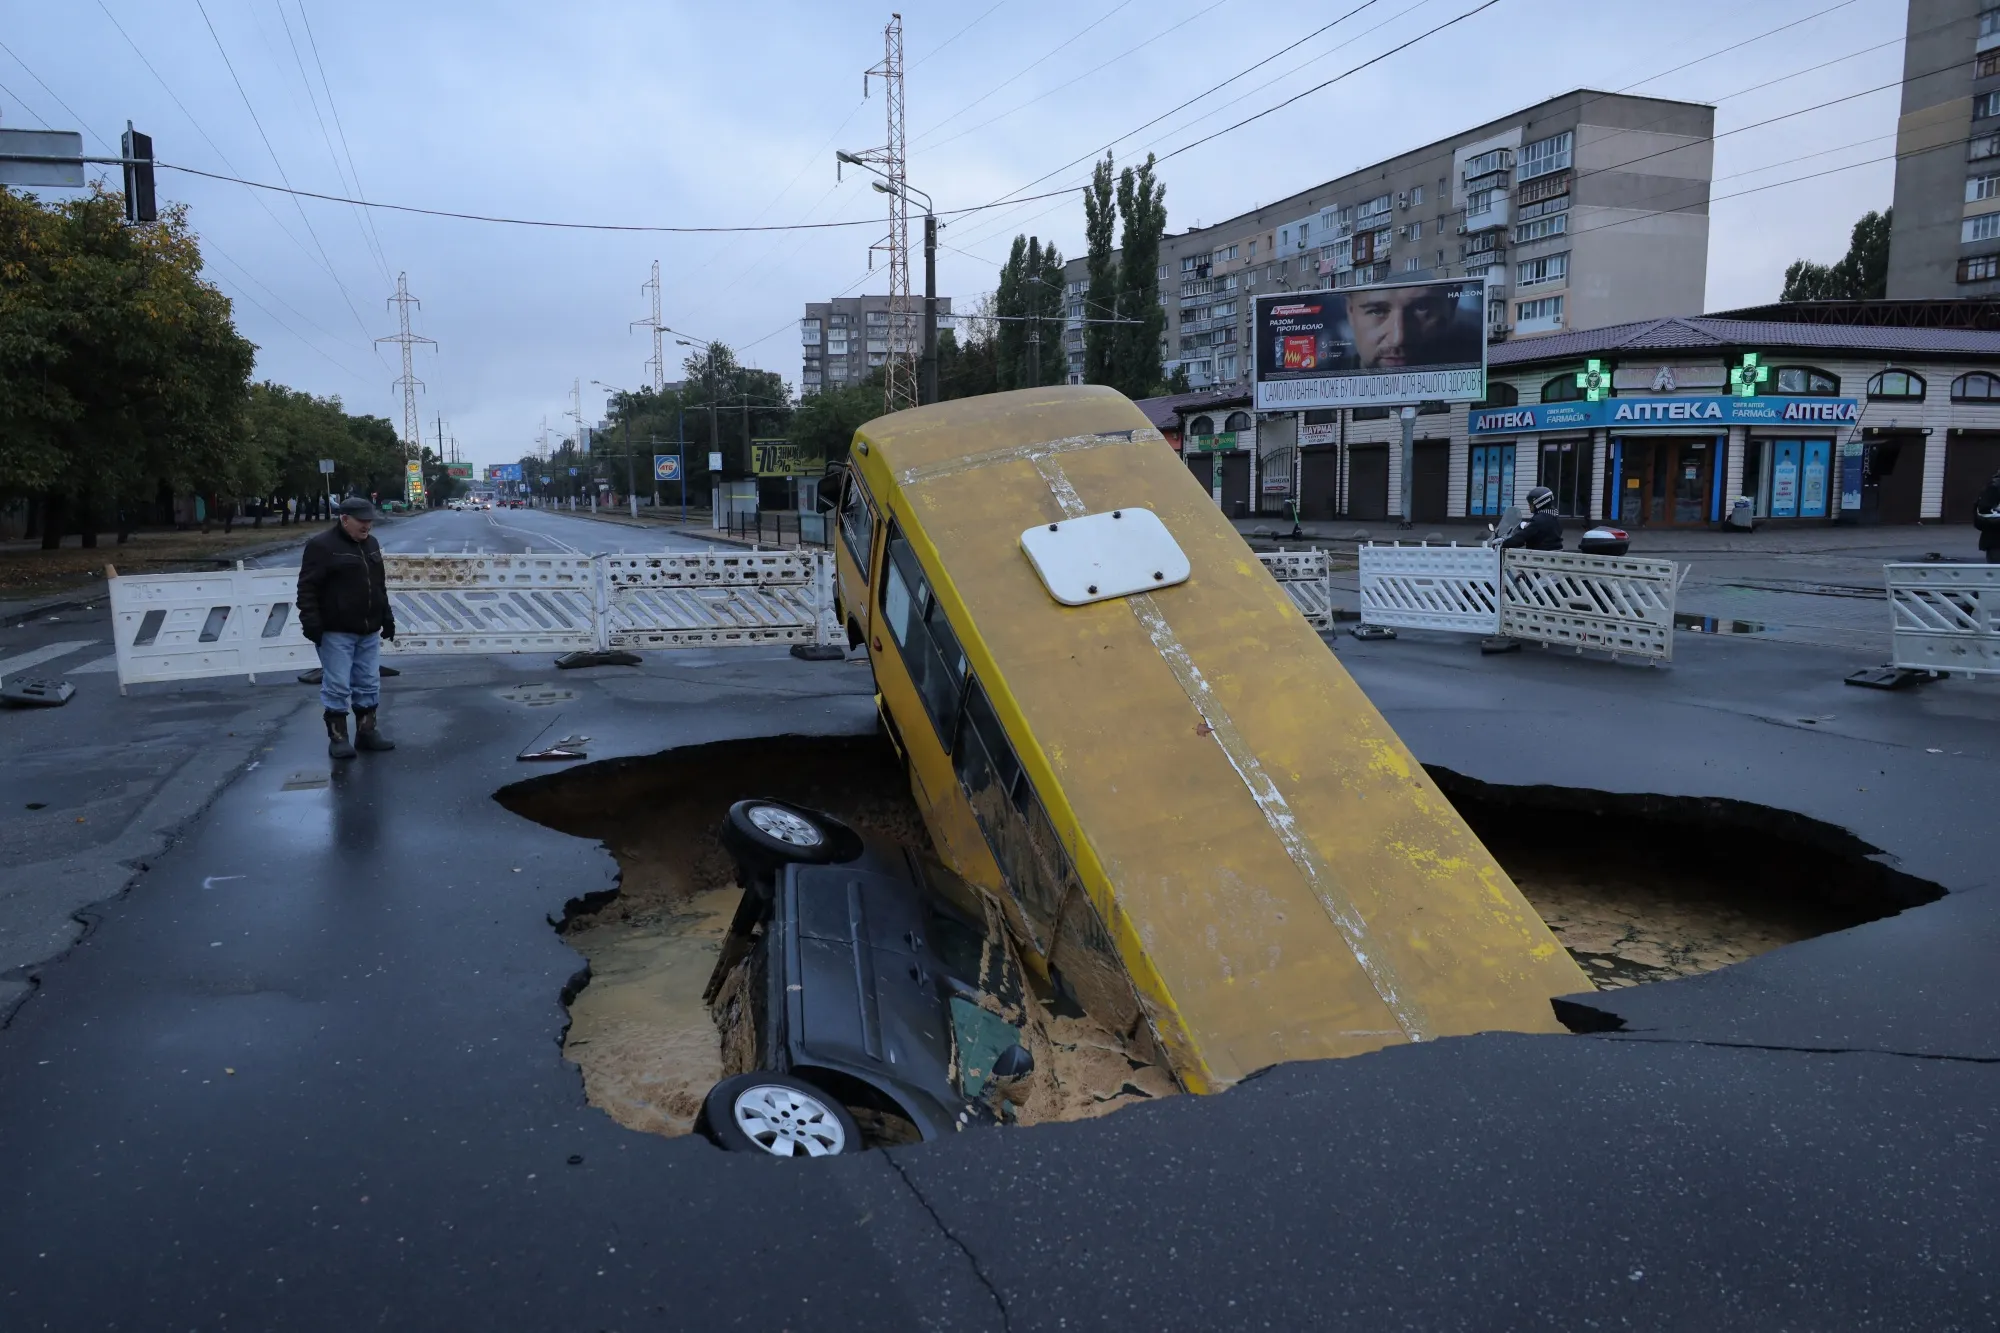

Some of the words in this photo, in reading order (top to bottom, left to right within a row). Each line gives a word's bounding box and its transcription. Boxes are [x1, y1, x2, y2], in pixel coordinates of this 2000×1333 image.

[1269, 318, 1294, 326] РАЗОМ
[1301, 323, 1324, 331] БОЛЮ
[1319, 379, 1339, 399] МОЖЕ
[1340, 378, 1357, 398] БУТИ
[1401, 374, 1416, 398] ДЛЯ
[1417, 373, 1446, 394] ВАШОГО
[1614, 401, 1723, 420] АПТЕКА
[1784, 402, 1857, 420] АПТЕКА
[1302, 424, 1332, 434] ШАУРМА
[1476, 411, 1536, 430] АПТЕКА
